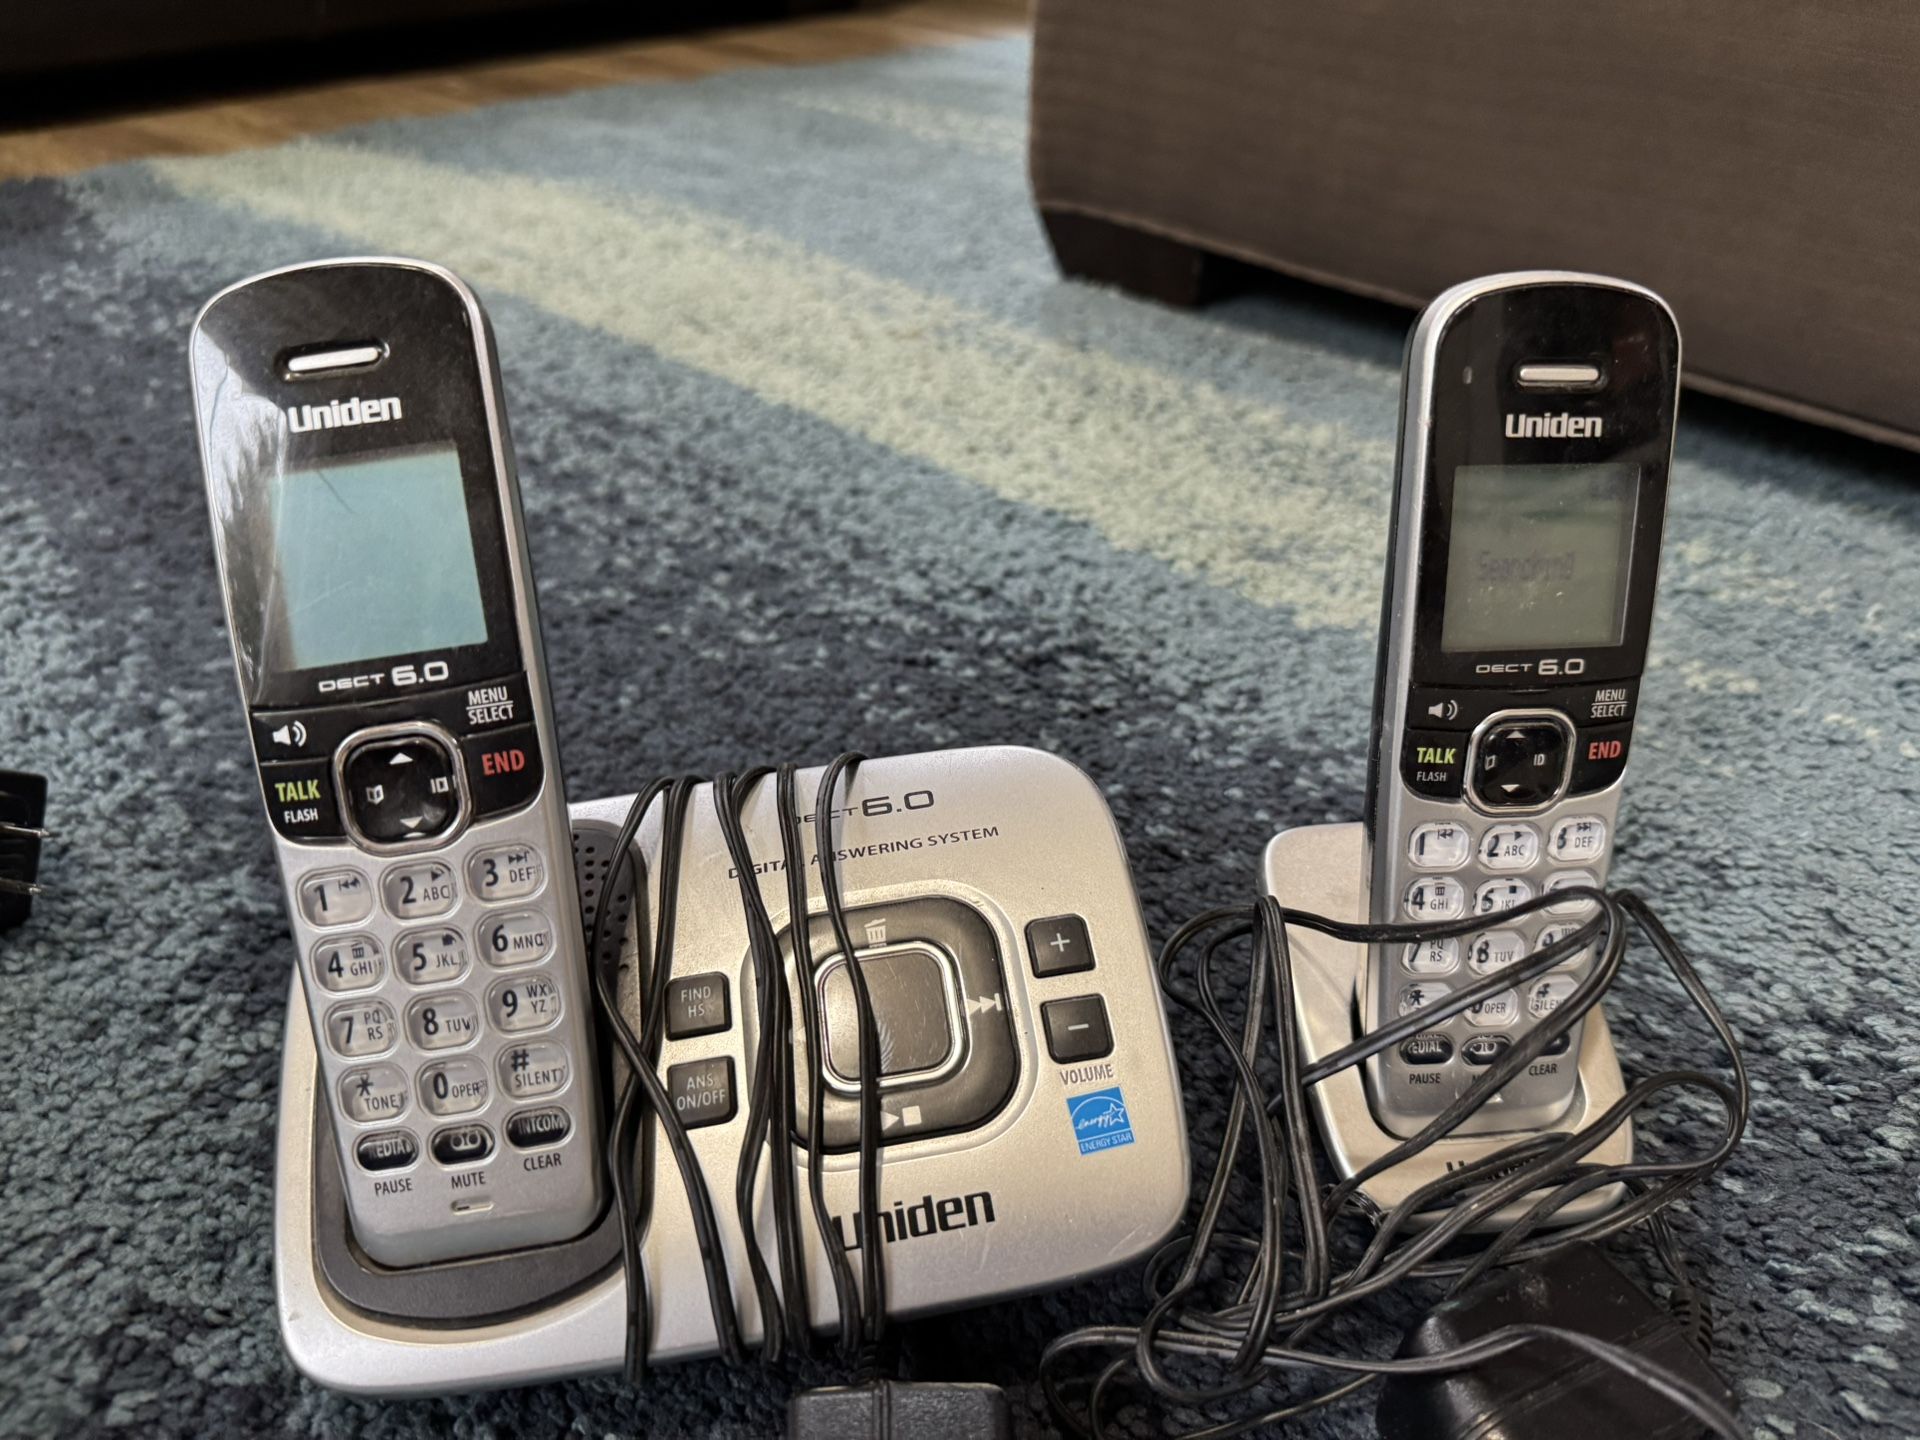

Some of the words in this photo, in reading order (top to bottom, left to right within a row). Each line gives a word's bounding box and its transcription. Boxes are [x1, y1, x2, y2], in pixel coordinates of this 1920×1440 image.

[287, 396, 402, 433] Uniden
[1505, 412, 1602, 438] Uniden
[1475, 663, 1533, 674] DECT
[1538, 658, 1585, 676] 6.0
[318, 673, 385, 693] DECT
[391, 661, 449, 686] 6.0
[467, 686, 509, 705] MENU
[1595, 689, 1626, 702] MENU
[468, 703, 514, 725] SELECT
[1590, 704, 1626, 719] SELECT
[1416, 747, 1456, 764] TALK
[1588, 740, 1622, 760] END
[481, 750, 526, 775] END
[1534, 754, 1545, 766] ID
[1416, 771, 1447, 782] FLASH
[275, 780, 321, 803] TALK
[284, 808, 319, 824] FLASH
[797, 806, 858, 825] ECT
[861, 789, 935, 817] 6.0
[1416, 832, 1426, 856] 1
[1487, 834, 1499, 858] 2
[1504, 845, 1525, 856] ABC
[1574, 836, 1594, 848] DEF
[728, 859, 805, 880] DGIT
[810, 837, 923, 866] ASWERING
[927, 826, 999, 847] SYSTEM
[483, 858, 499, 887] 3
[509, 865, 535, 883] DEF
[314, 884, 328, 911] 1
[400, 876, 417, 905] 2
[423, 884, 451, 902] ABC
[1411, 886, 1425, 911] 4
[1430, 899, 1449, 911] GHI
[492, 924, 508, 952] 6
[328, 951, 344, 978] 4
[350, 957, 374, 977] GHI
[412, 943, 427, 972] 5
[435, 950, 460, 968] JKL
[1430, 951, 1443, 962] RS
[1494, 951, 1514, 962] TUV
[526, 983, 548, 999] WX
[680, 986, 711, 1003] FIND
[502, 989, 518, 1018] 9
[531, 1000, 547, 1014] YZ
[688, 1003, 705, 1018] HS
[1485, 1002, 1506, 1013] OPER
[340, 1015, 354, 1045] 7
[422, 1008, 439, 1036] 8
[367, 1027, 383, 1041] RS
[514, 1069, 558, 1088] SILENT
[1060, 1064, 1113, 1085] VOLUME
[1409, 1073, 1441, 1085] PAUSE
[1529, 1063, 1557, 1076] CLEAR
[432, 1071, 448, 1099] 0
[687, 1073, 714, 1091] ANS
[364, 1095, 398, 1112] TONE
[676, 1089, 725, 1111] ON/OFF
[1080, 1138, 1111, 1153] ENERGY
[1111, 1131, 1132, 1145] STAR
[523, 1153, 562, 1172] CLEAR
[374, 1177, 413, 1196] PAUSE
[451, 1171, 486, 1189] MUTE
